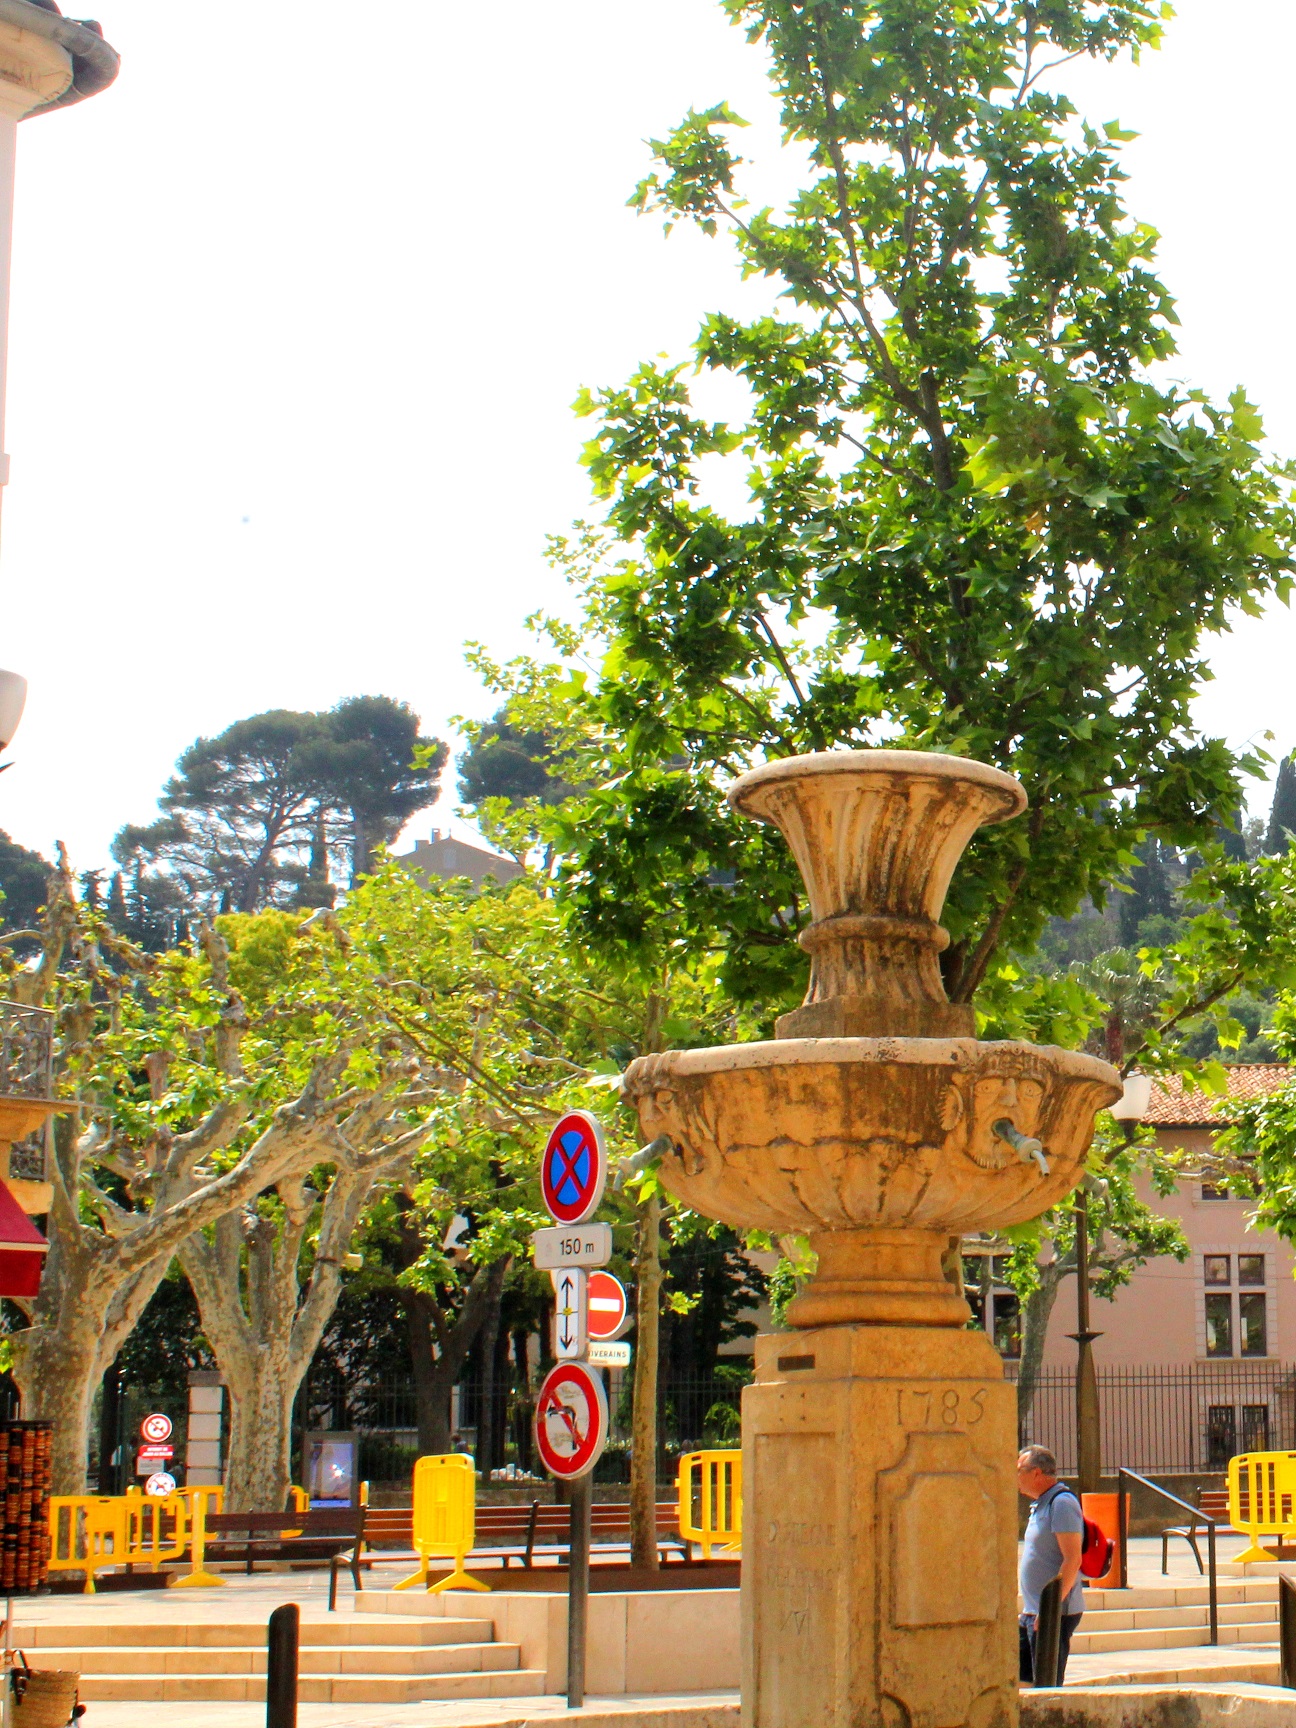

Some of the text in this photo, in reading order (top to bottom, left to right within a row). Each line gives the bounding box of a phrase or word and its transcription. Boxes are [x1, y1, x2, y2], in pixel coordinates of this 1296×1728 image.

[560, 1238, 595, 1255] 150 m
[589, 1350, 627, 1358] IVERAINS
[897, 1388, 987, 1426] 1785
